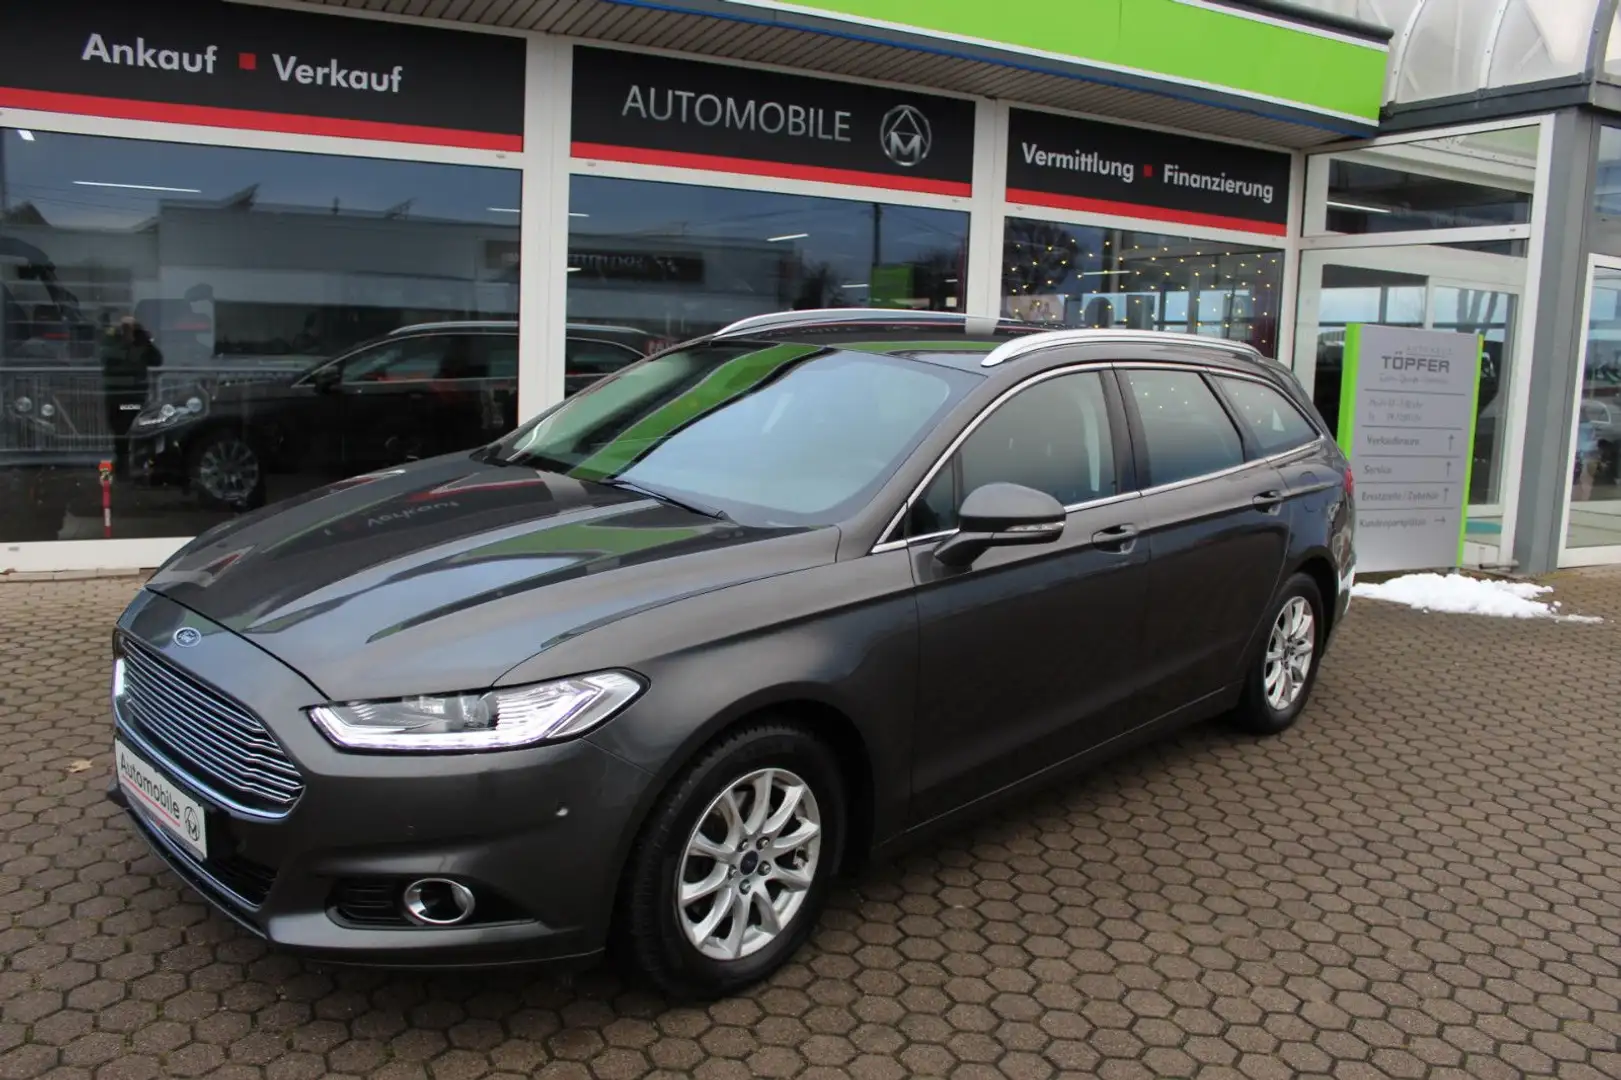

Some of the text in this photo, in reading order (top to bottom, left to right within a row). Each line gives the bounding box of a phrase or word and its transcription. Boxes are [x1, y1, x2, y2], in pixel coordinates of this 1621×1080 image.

[81, 33, 403, 93] Ankauf Verkauf
[621, 84, 851, 142] AUTOMOBILE
[1022, 142, 1274, 204] Vermittlung Finanzierung
[1381, 351, 1450, 374] TÖPFER
[120, 752, 180, 820] Automobile
